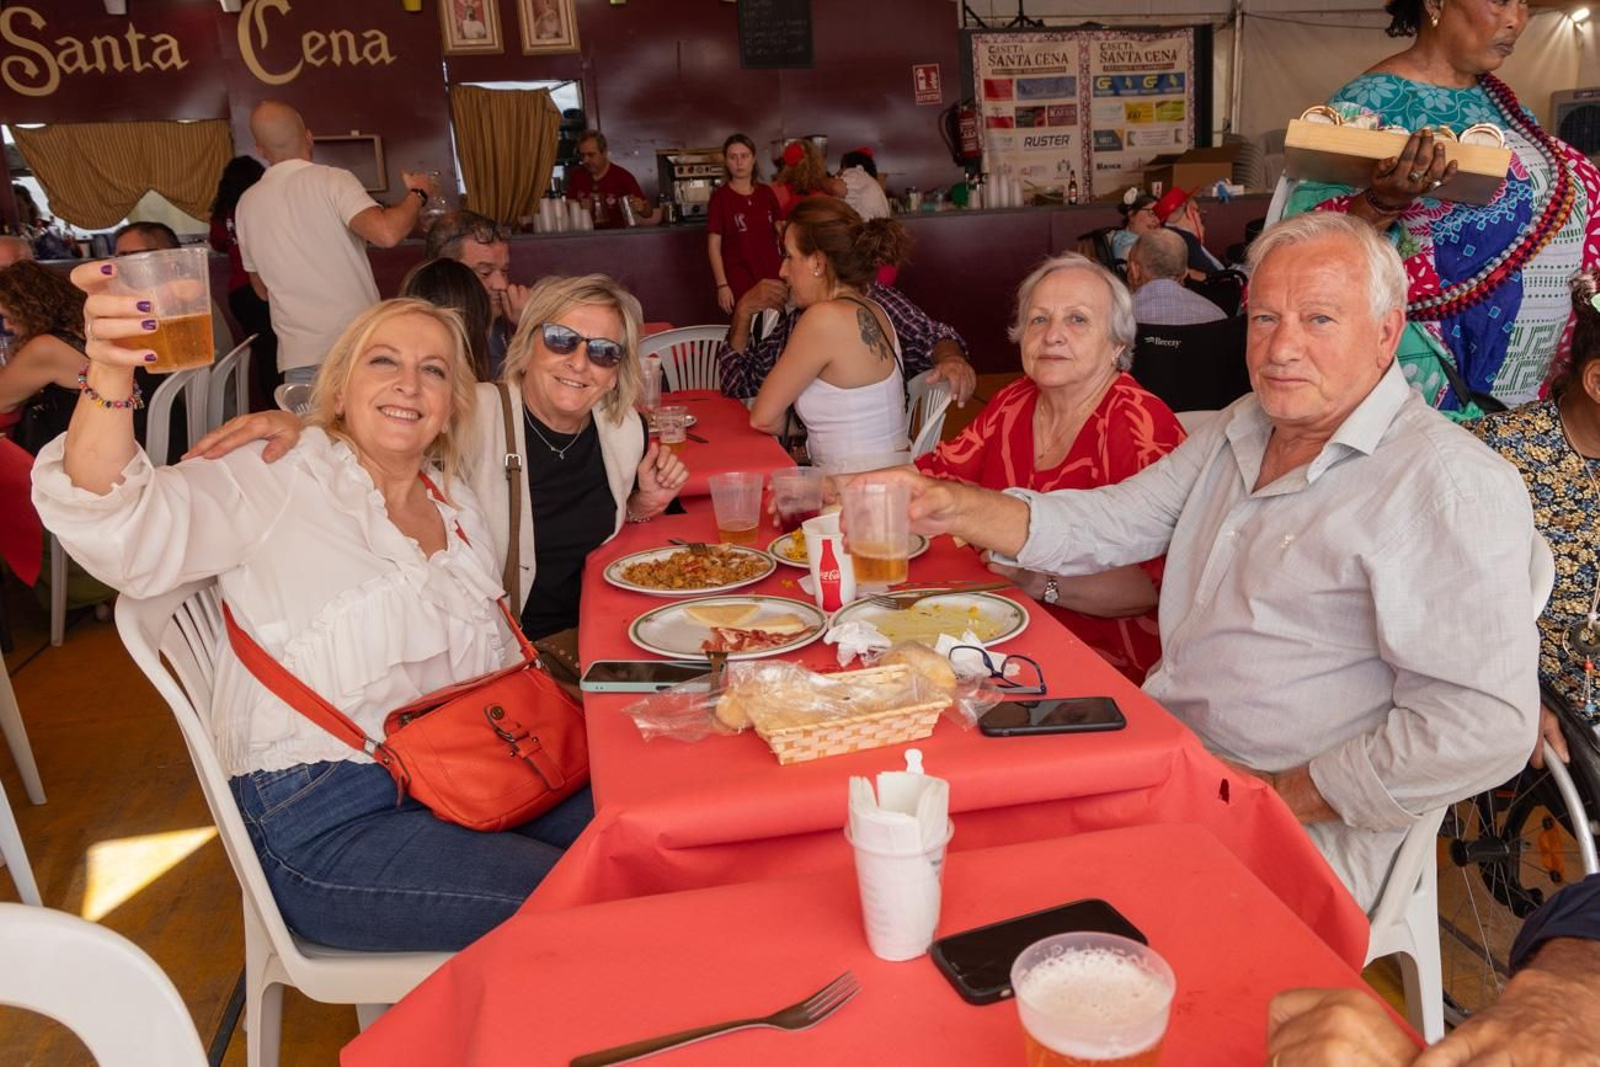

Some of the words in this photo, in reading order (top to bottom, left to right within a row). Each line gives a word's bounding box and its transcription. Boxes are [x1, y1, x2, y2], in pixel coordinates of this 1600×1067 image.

[0, 6, 189, 97] Santa
[237, 0, 398, 86] Cena
[988, 54, 1031, 67] SANTA
[1035, 52, 1068, 66] CENA
[1100, 50, 1142, 64] SANTA
[1144, 49, 1177, 62] CENA
[1024, 134, 1070, 147] RUSTER
